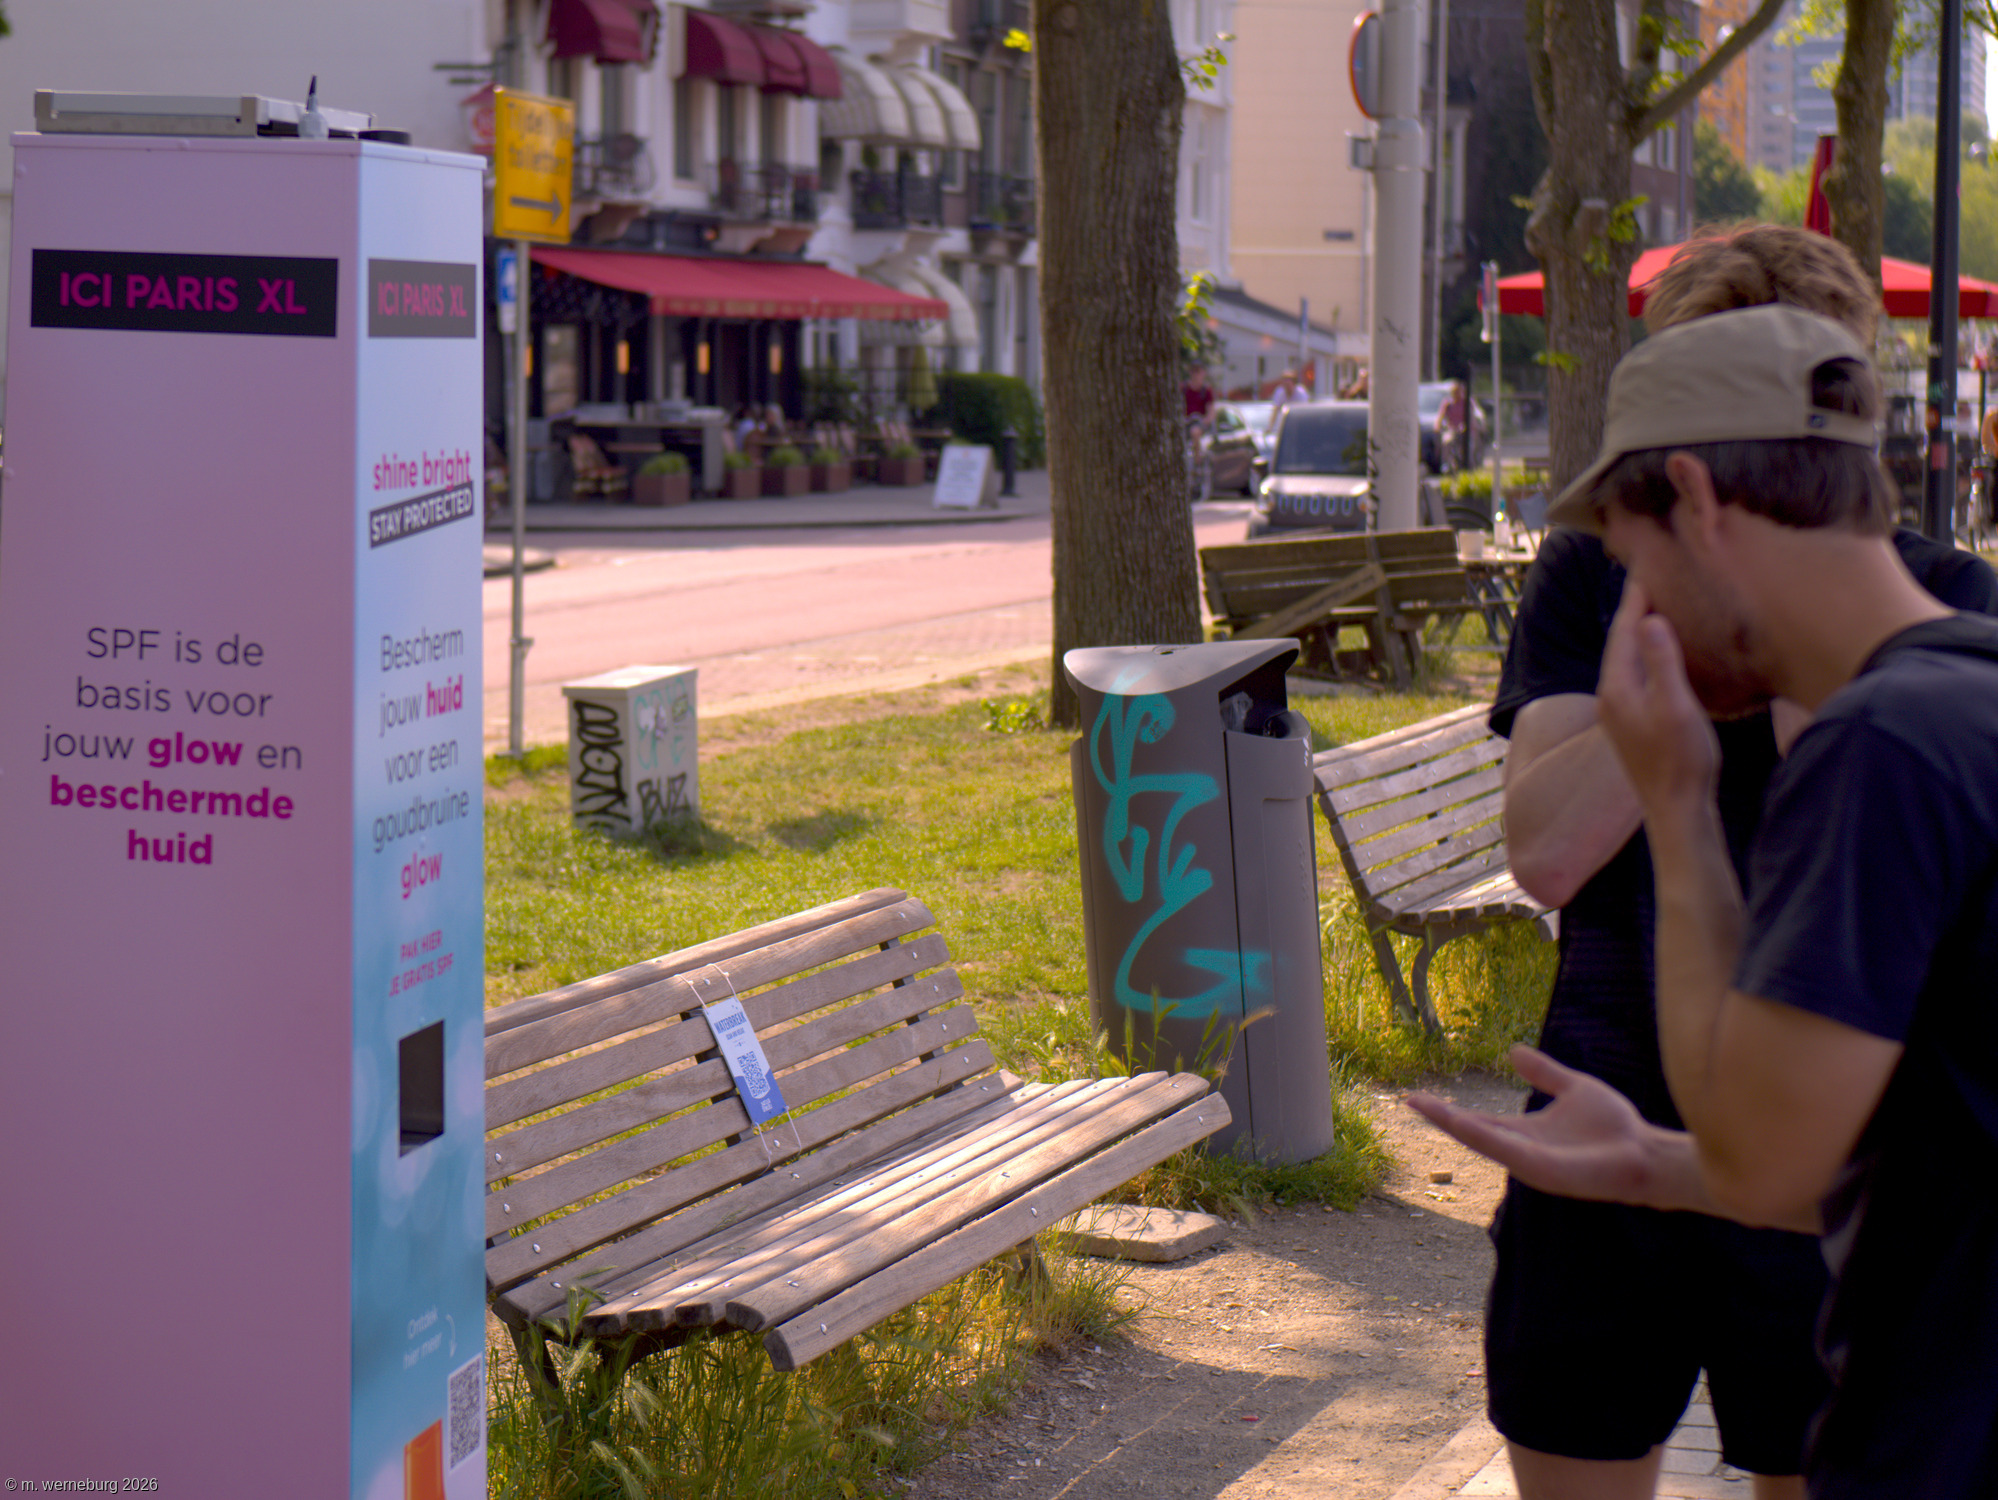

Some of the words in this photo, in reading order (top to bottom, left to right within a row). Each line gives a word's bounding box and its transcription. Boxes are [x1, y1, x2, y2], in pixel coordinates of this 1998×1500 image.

[60, 272, 112, 307] ICI
[127, 274, 239, 312] PARIS
[256, 278, 307, 314] XL
[377, 282, 400, 317] ICI
[403, 283, 445, 318] PARIS
[449, 286, 468, 318] XL
[373, 453, 418, 490] shine
[423, 449, 471, 491] bright
[371, 507, 402, 541] STAY
[403, 488, 472, 531] PROTECTED
[86, 627, 160, 660] SPF
[174, 631, 202, 663] is
[216, 634, 264, 666] de
[381, 627, 464, 672] Bescherm
[77, 676, 171, 712] basis
[186, 690, 273, 717] voor
[379, 693, 422, 738] jouw
[426, 674, 463, 718] huid
[42, 725, 135, 761] jouw
[148, 732, 244, 768] glow
[257, 744, 302, 769] en
[385, 749, 425, 784] voor
[428, 738, 459, 772] een
[51, 775, 294, 819] beschermde
[373, 786, 470, 853] goudbruine
[128, 830, 213, 865] huid
[401, 852, 442, 900] glow
[401, 941, 419, 963] PAK
[421, 929, 443, 955] HIER
[389, 974, 401, 997] JE
[402, 958, 435, 991] GRATIS
[437, 952, 454, 976] SPF
